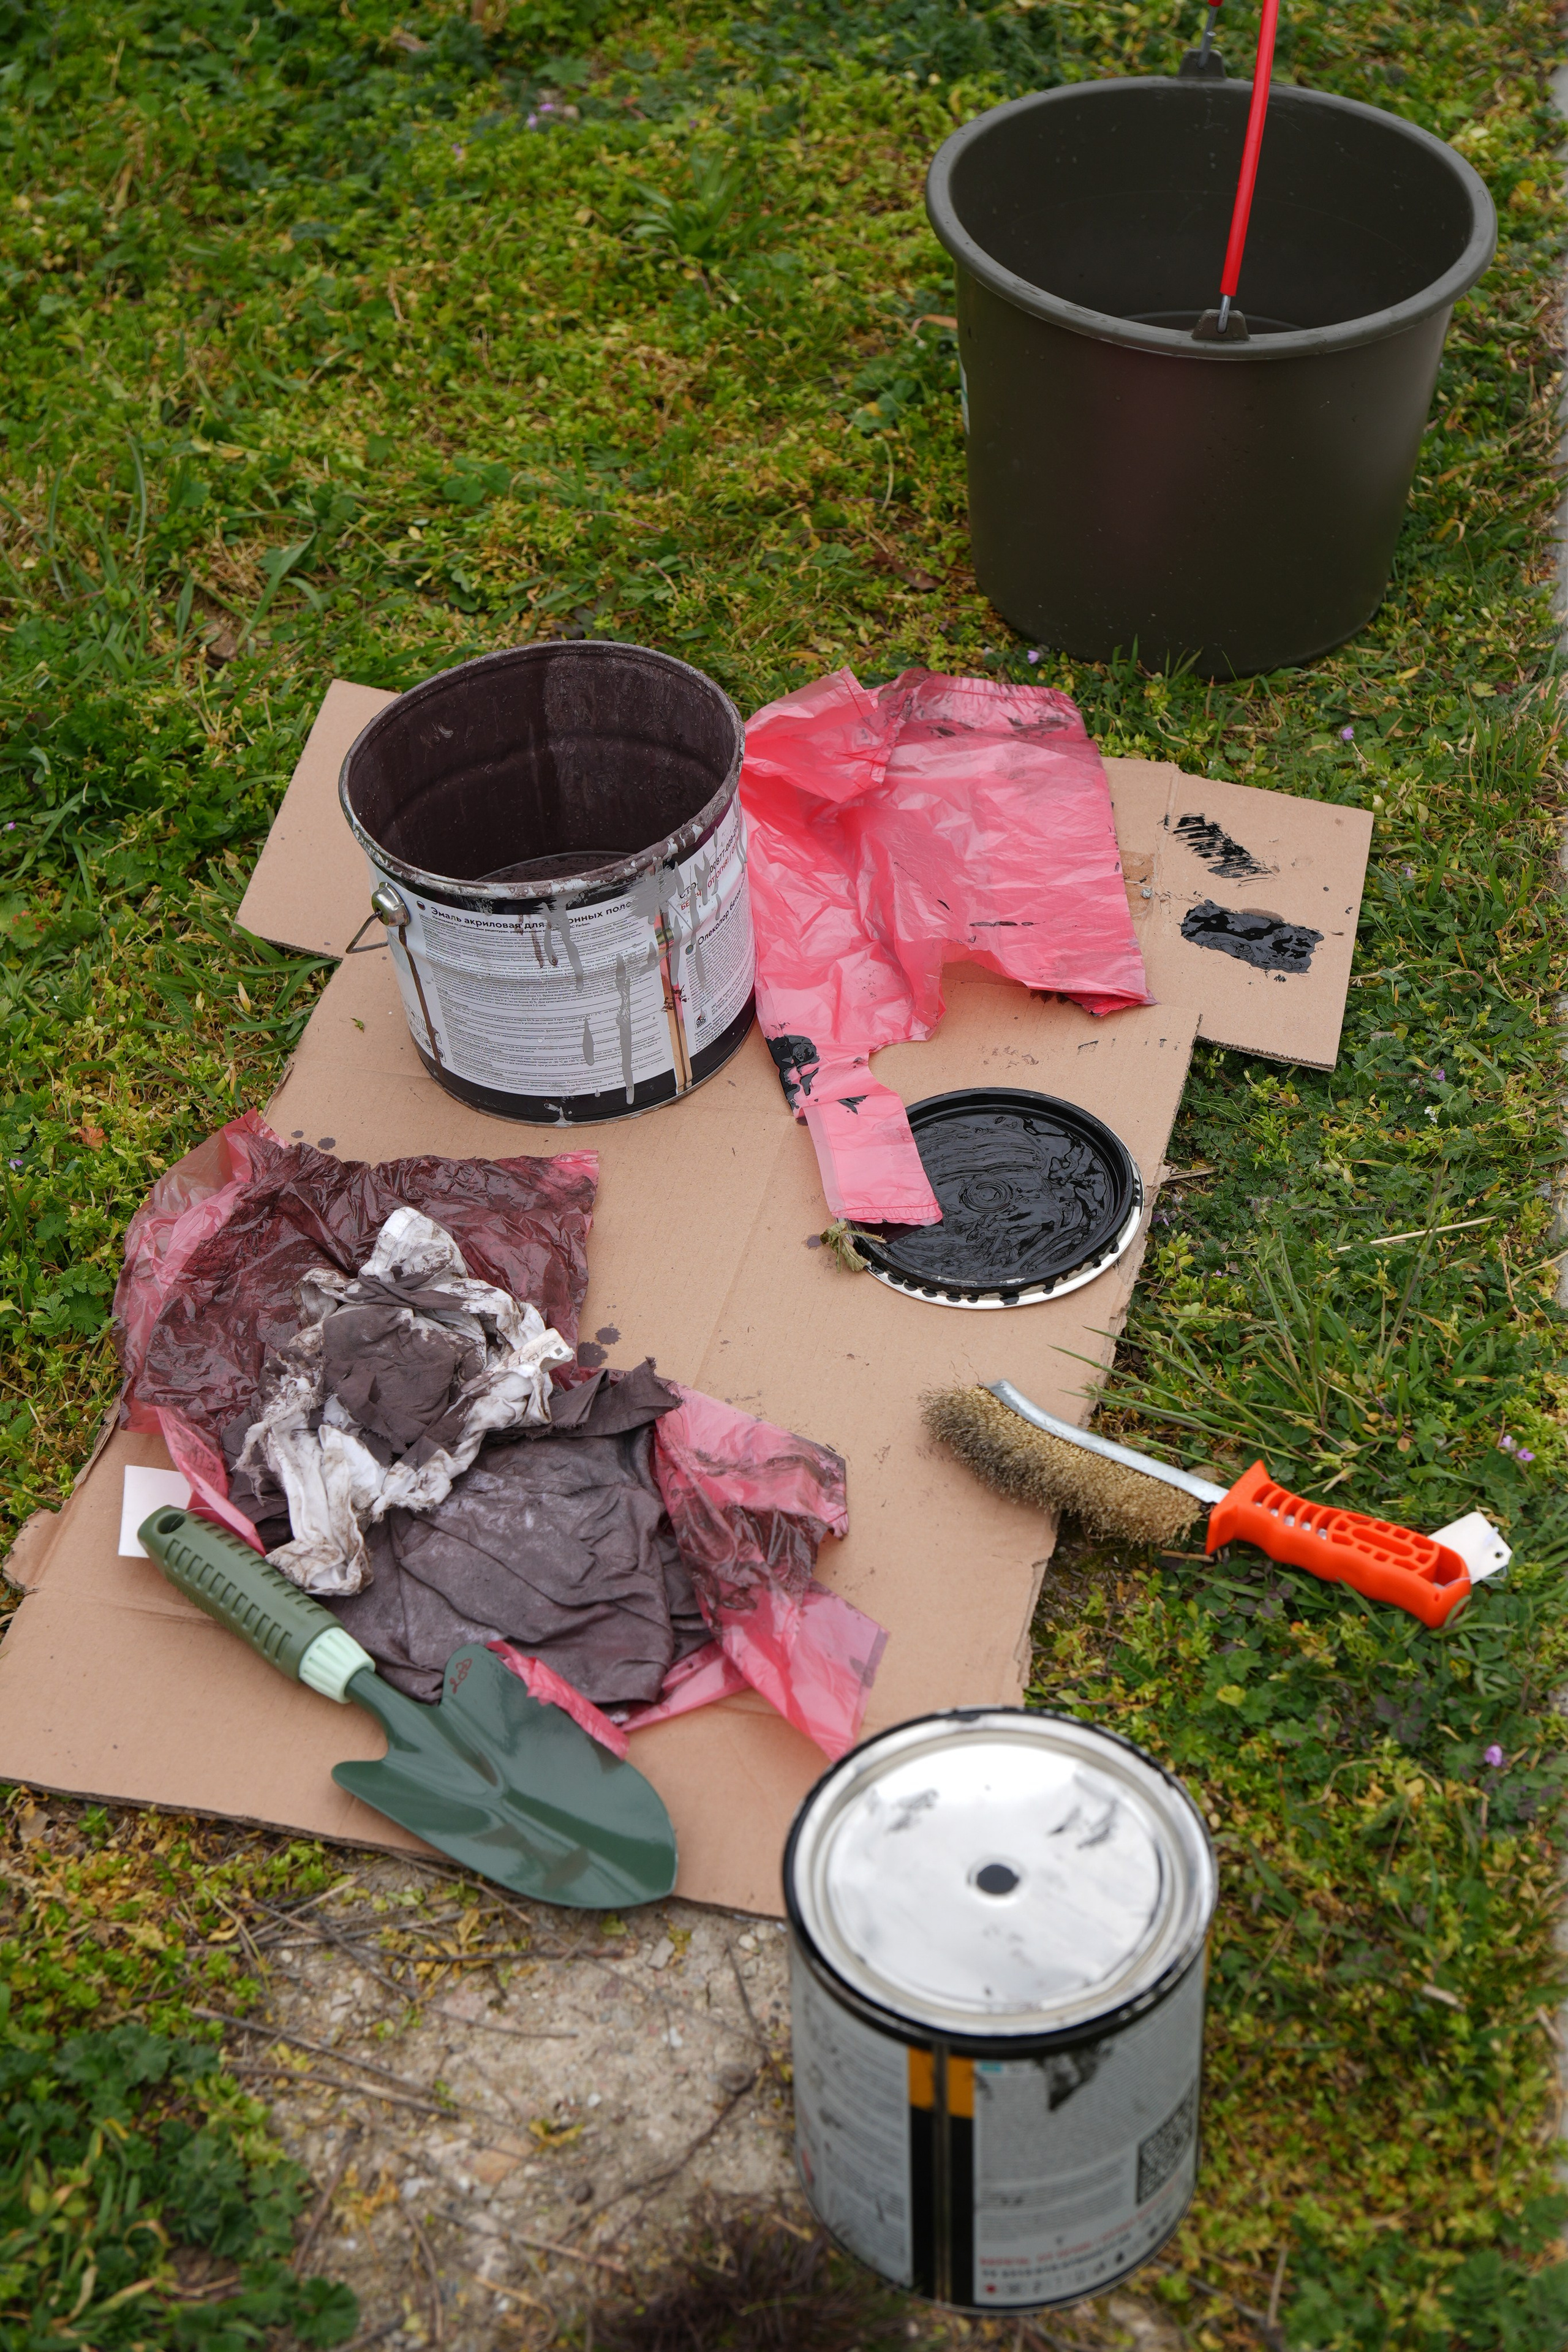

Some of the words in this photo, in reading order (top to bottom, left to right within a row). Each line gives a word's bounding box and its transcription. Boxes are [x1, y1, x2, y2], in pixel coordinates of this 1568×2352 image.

[707, 876, 715, 888] ОТ
[715, 858, 729, 878] ОГНЯ!
[431, 907, 461, 921] Эмаль
[464, 918, 521, 930] акриловая
[698, 910, 729, 945] Олеколор
